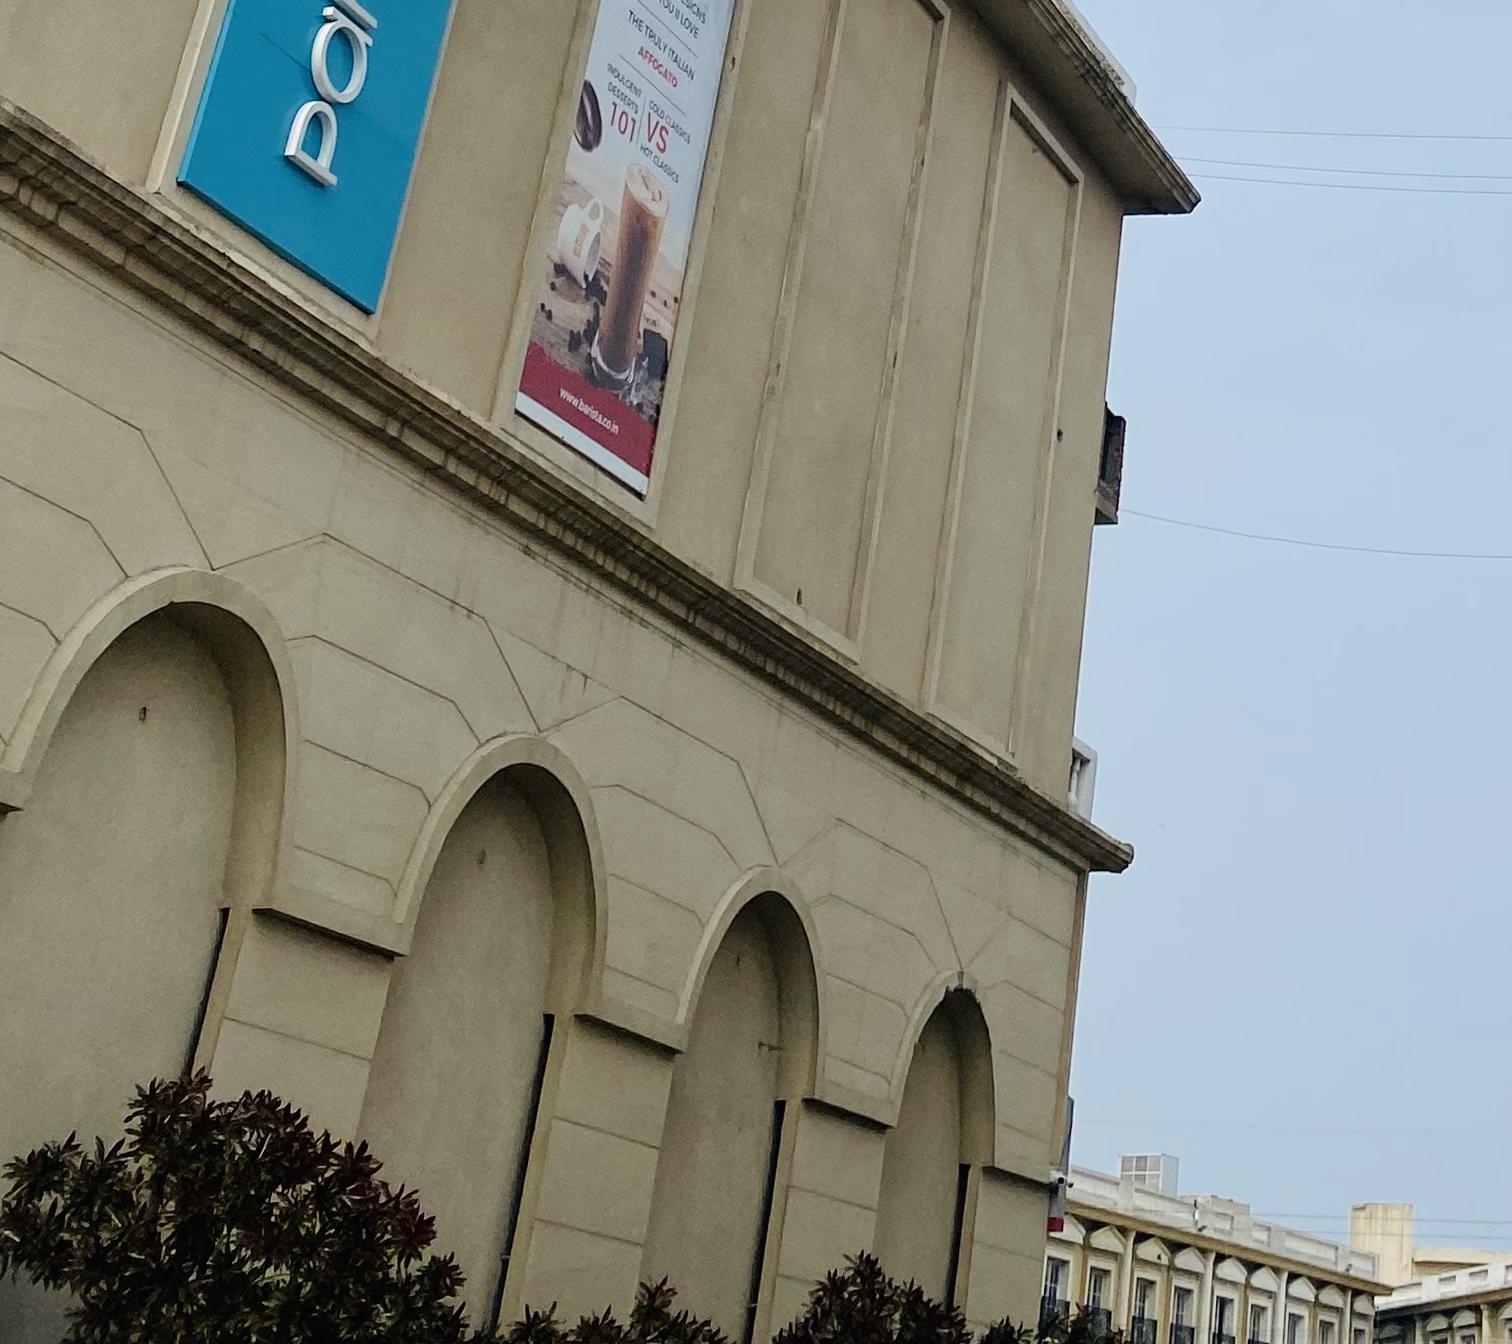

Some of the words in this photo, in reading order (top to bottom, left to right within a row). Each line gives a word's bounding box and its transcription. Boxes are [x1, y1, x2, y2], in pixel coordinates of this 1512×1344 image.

[629, 9, 643, 32] THE
[638, 46, 678, 88] AFFOGATO
[611, 101, 636, 143] 101
[647, 112, 669, 154] VS
